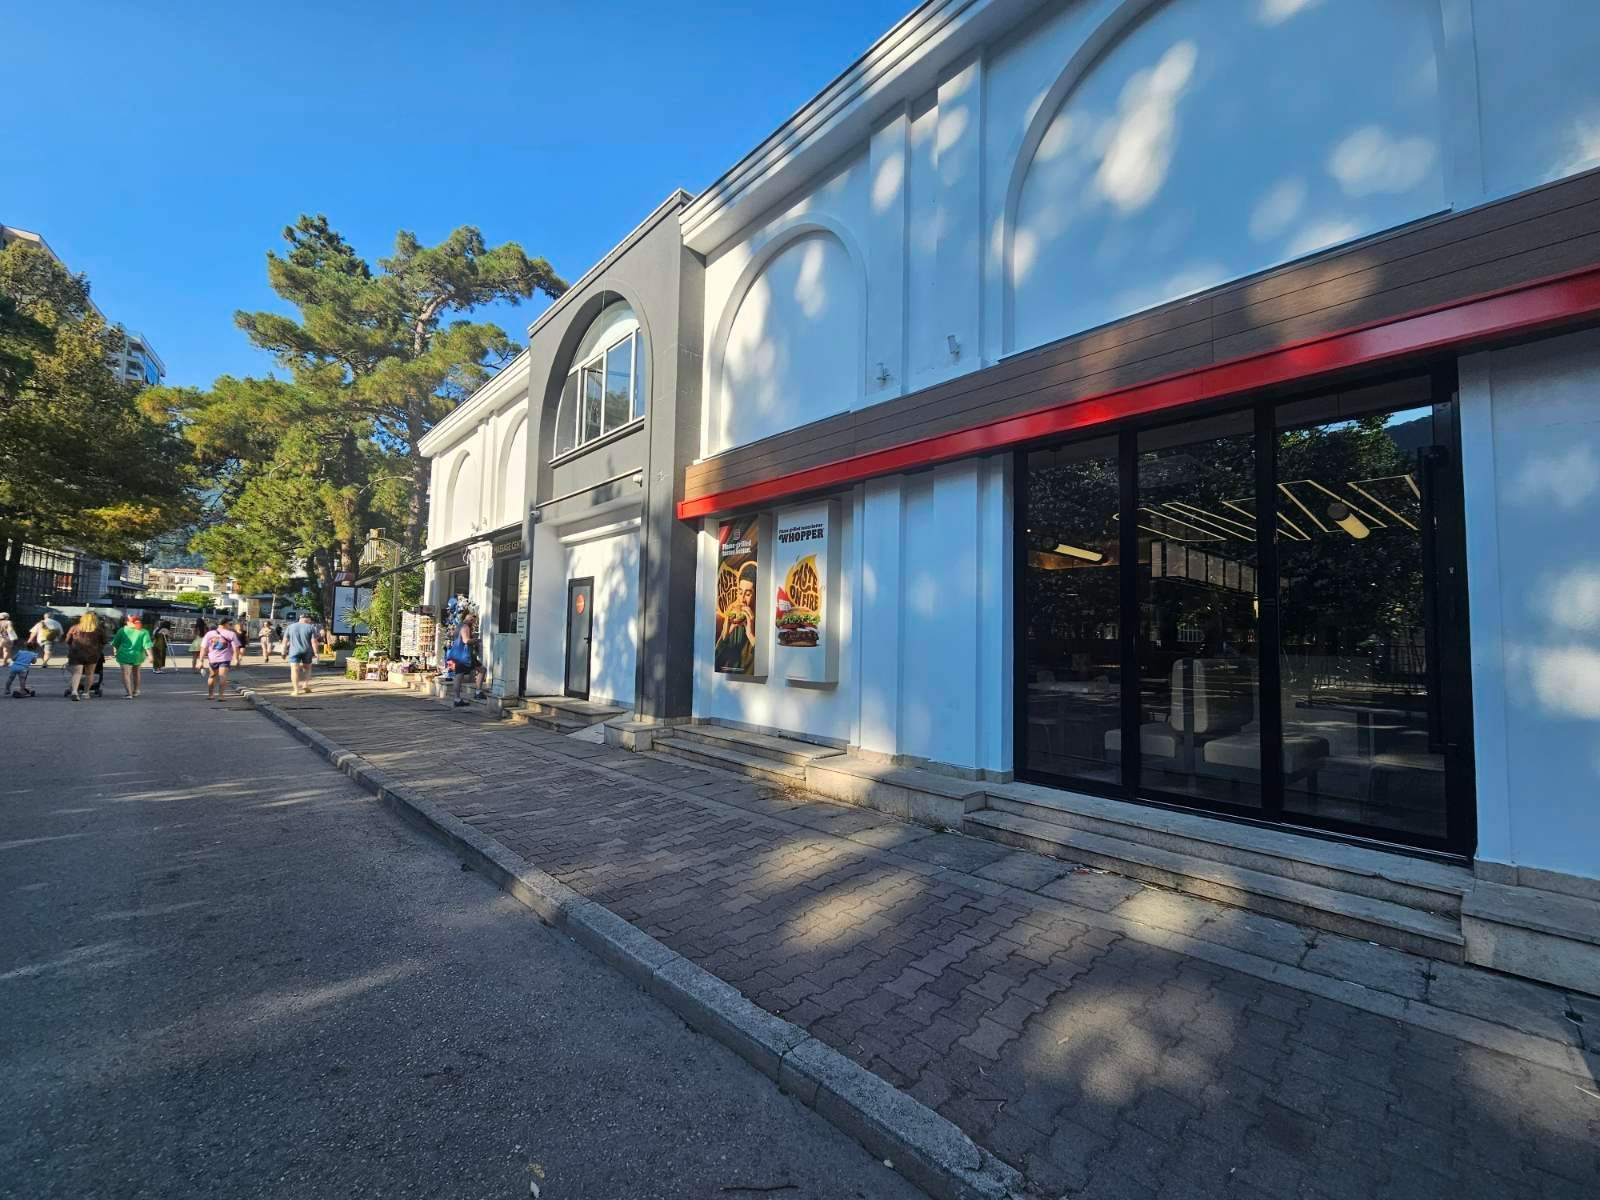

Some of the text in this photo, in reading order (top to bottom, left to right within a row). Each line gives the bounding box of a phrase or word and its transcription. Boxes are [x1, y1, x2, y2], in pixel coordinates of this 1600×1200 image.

[778, 528, 824, 544] WHOPPER
[718, 568, 738, 593] TASTE
[791, 562, 818, 594] TASTE
[789, 584, 819, 612] ON FIRE
